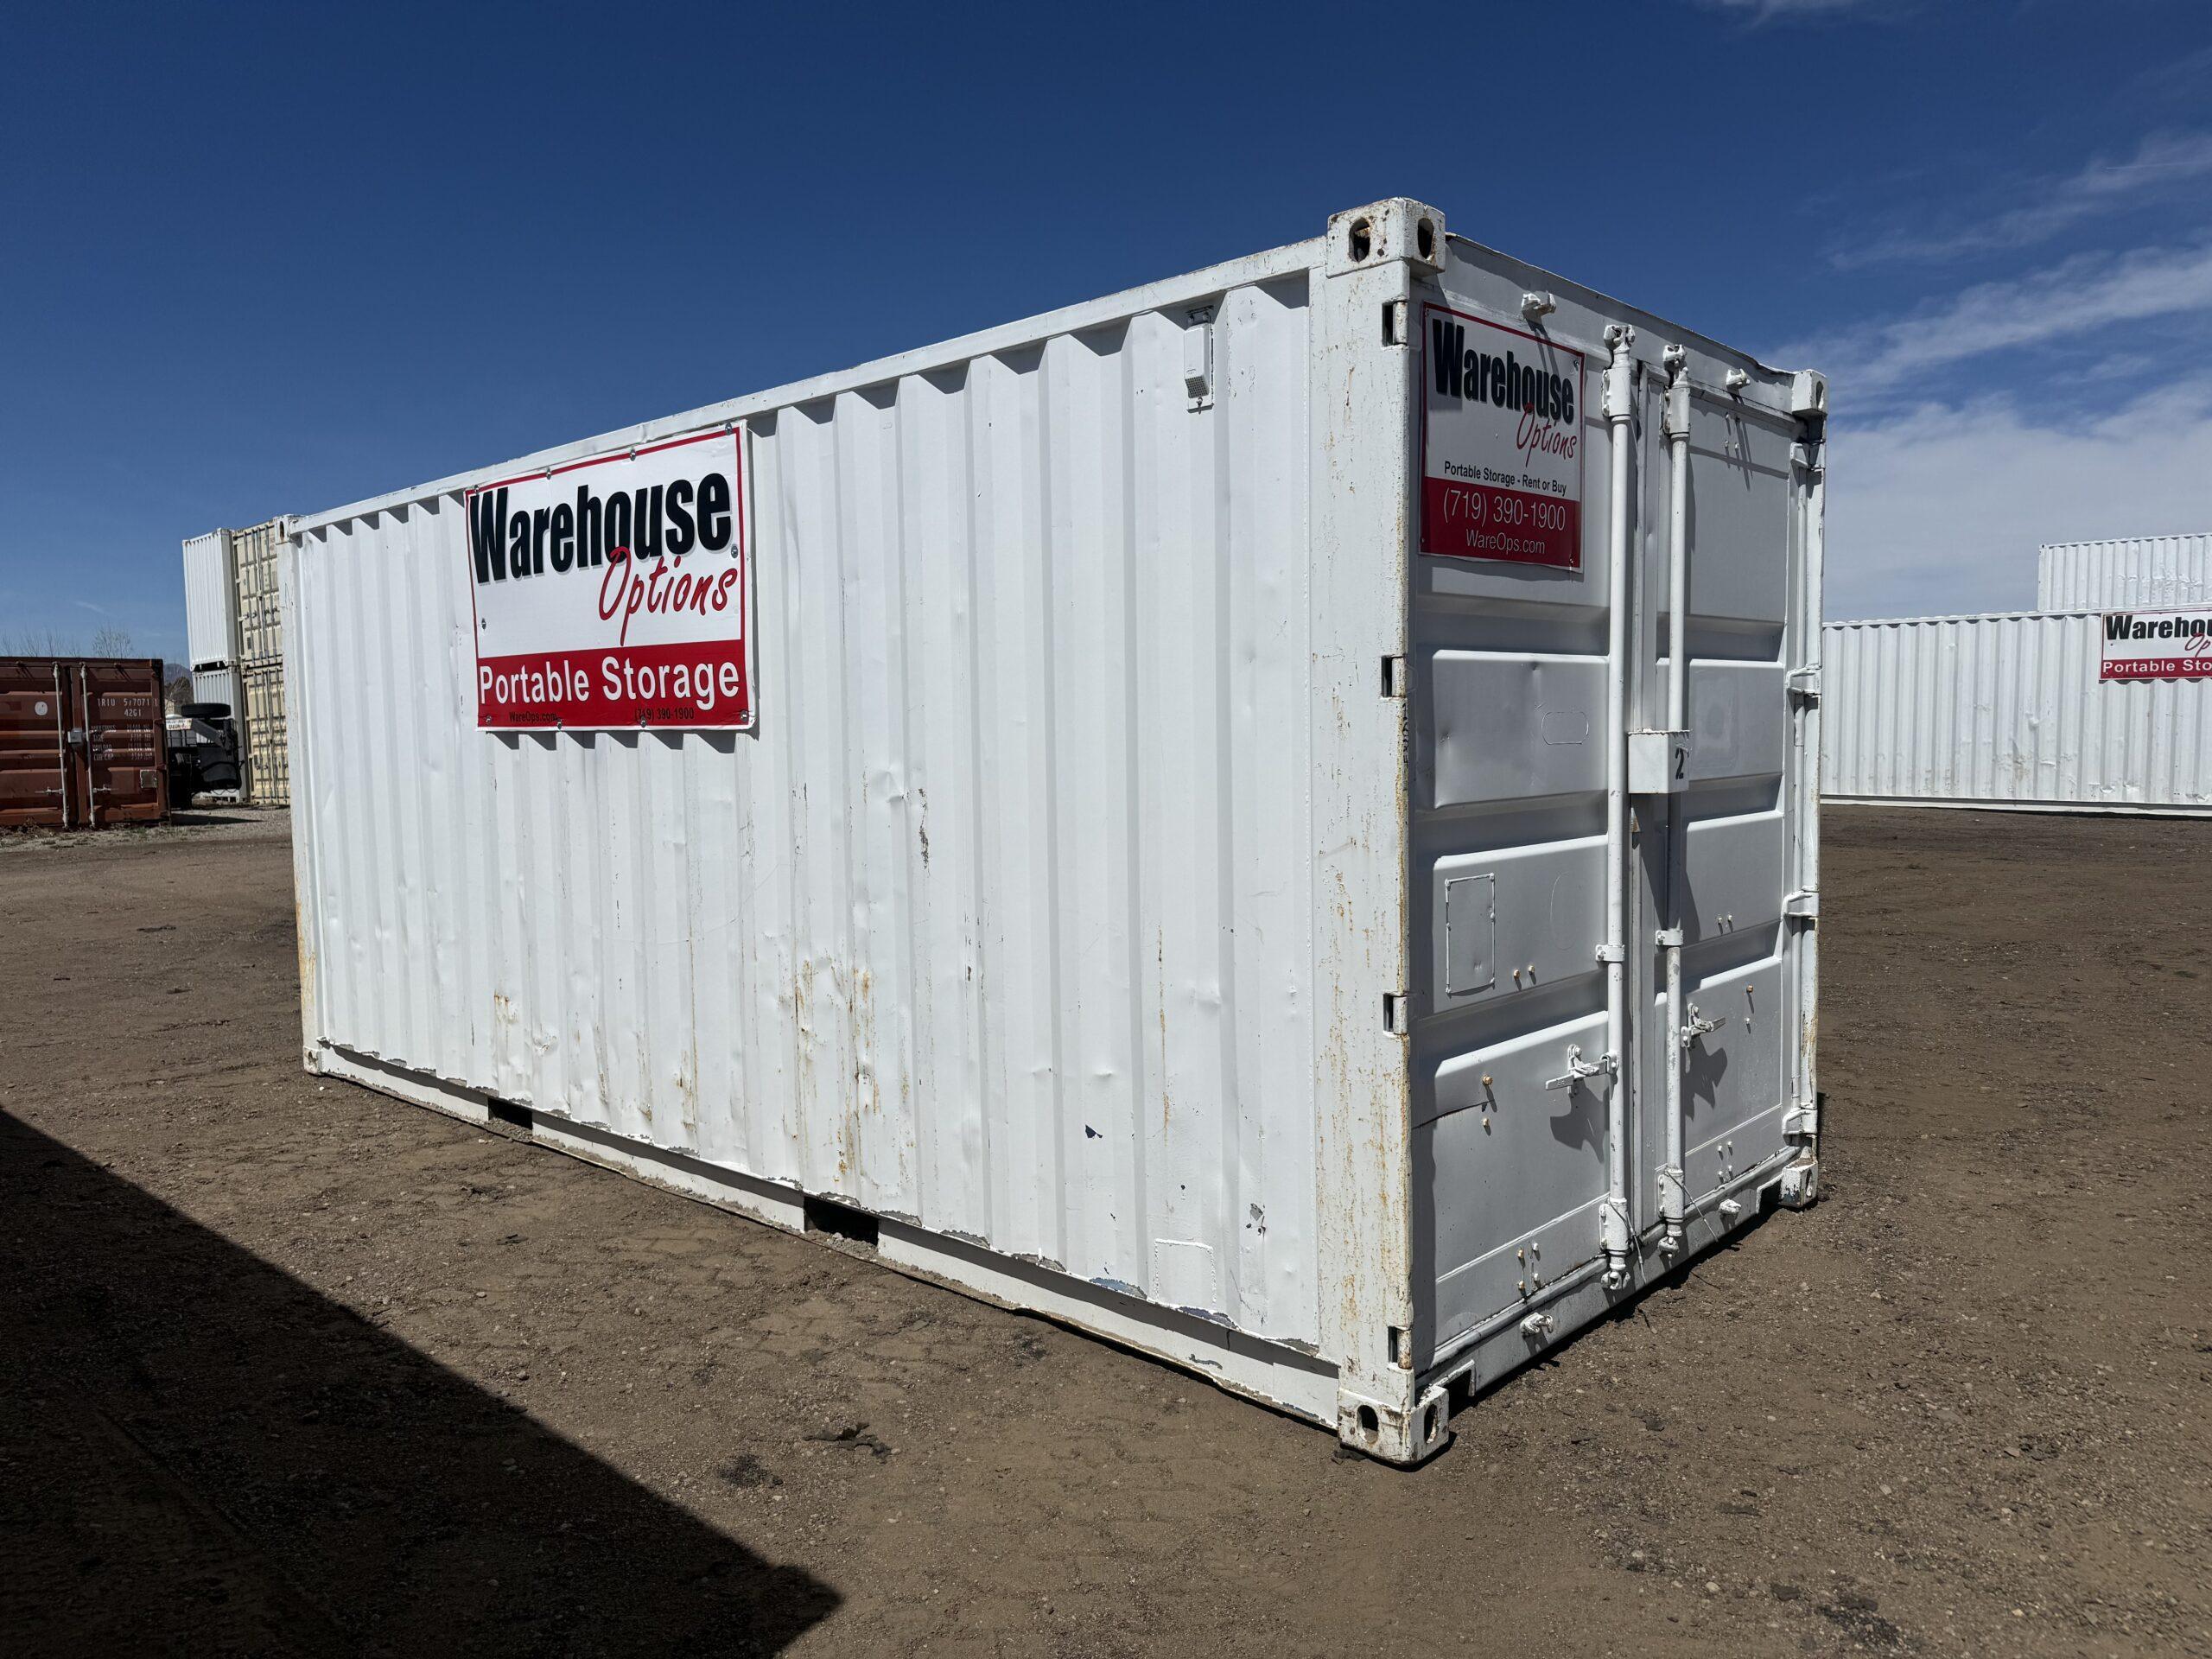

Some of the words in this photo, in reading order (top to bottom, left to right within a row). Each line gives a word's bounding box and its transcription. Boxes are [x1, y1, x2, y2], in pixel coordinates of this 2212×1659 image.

[1433, 319, 1574, 425] Warehouse
[1516, 402, 1577, 467] Options
[1444, 461, 1481, 480] Portable
[1483, 467, 1516, 486] Storage
[1522, 474, 1541, 490] Rent
[1541, 480, 1550, 491] or
[1551, 479, 1567, 496] Buy
[470, 473, 733, 584] Warehouse
[1444, 487, 1487, 527] (719)
[1493, 495, 1566, 531] 390-1900
[1465, 528, 1545, 554] WareOps.com
[599, 546, 738, 646] Options
[480, 660, 589, 704] Portable
[602, 656, 740, 710] Storage
[2102, 660, 2175, 673] Portable
[509, 711, 558, 724] WareOps.com
[657, 707, 695, 720] 390-1900
[1675, 747, 1684, 780] 2
